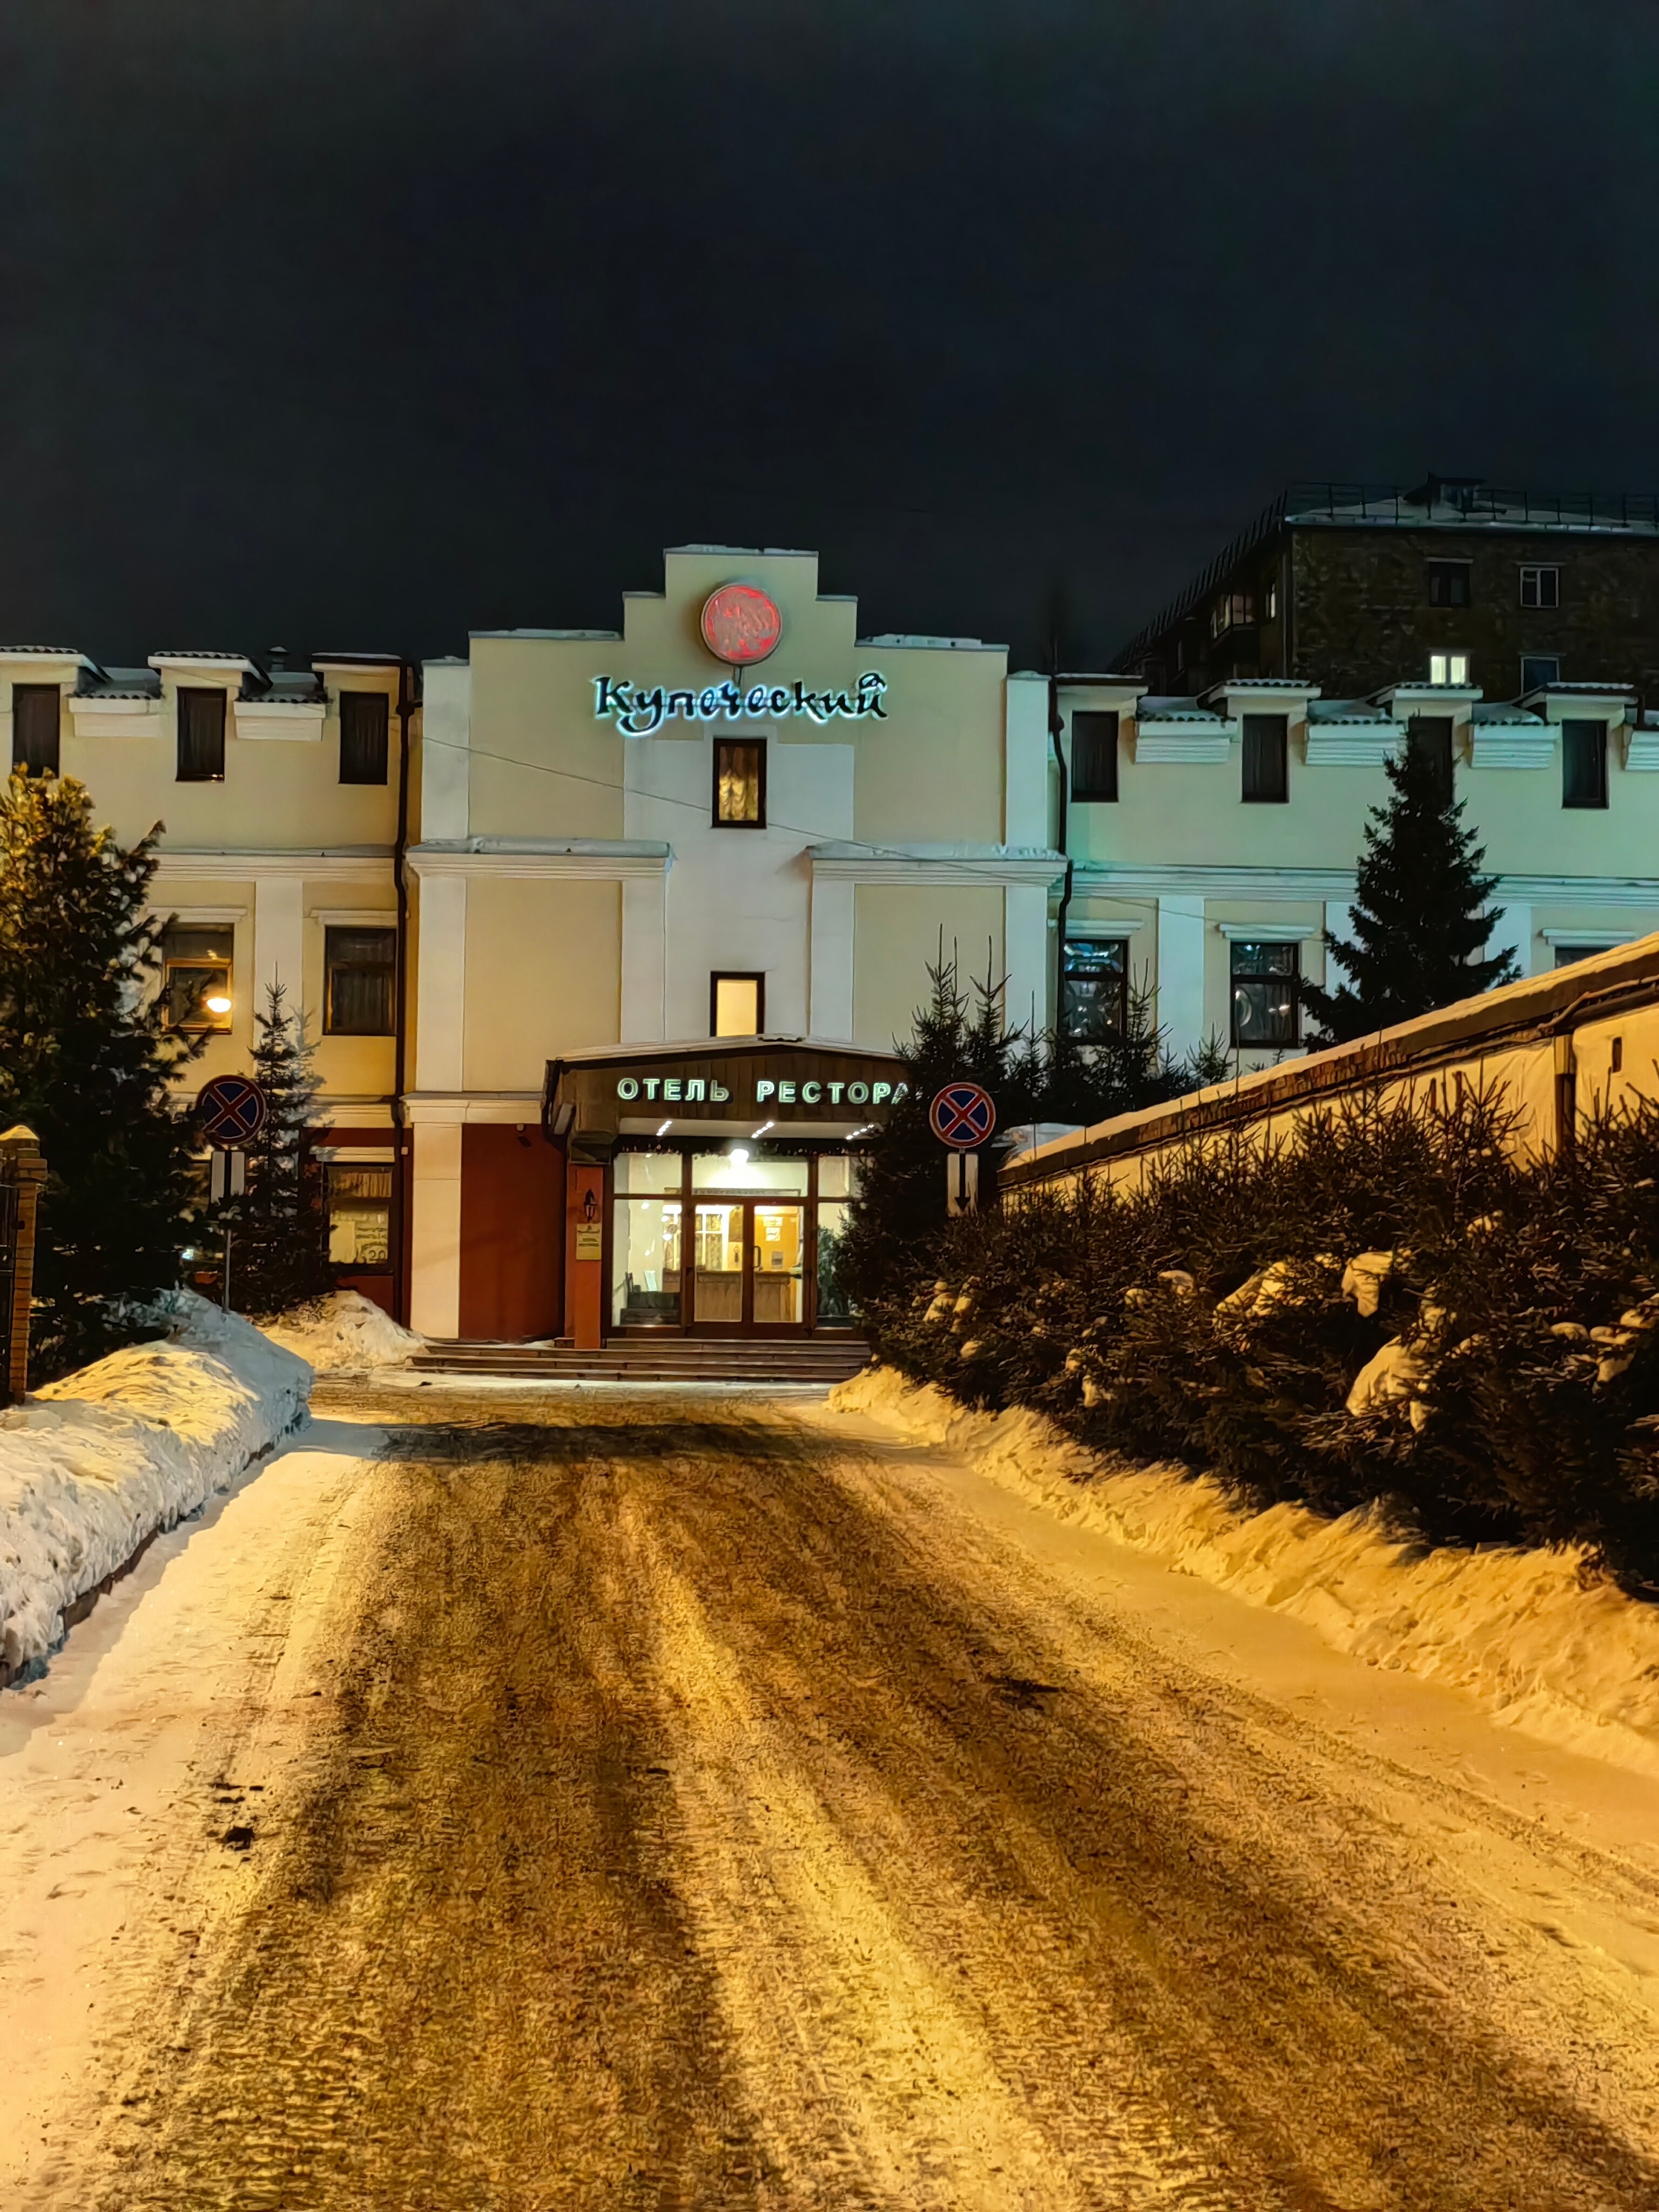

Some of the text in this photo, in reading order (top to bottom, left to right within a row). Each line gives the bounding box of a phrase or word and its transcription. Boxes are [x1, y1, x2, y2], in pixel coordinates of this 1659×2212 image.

[593, 671, 888, 735] Купеческий
[617, 1077, 924, 1105] ОТЕЛЬ РЕСТОРА
